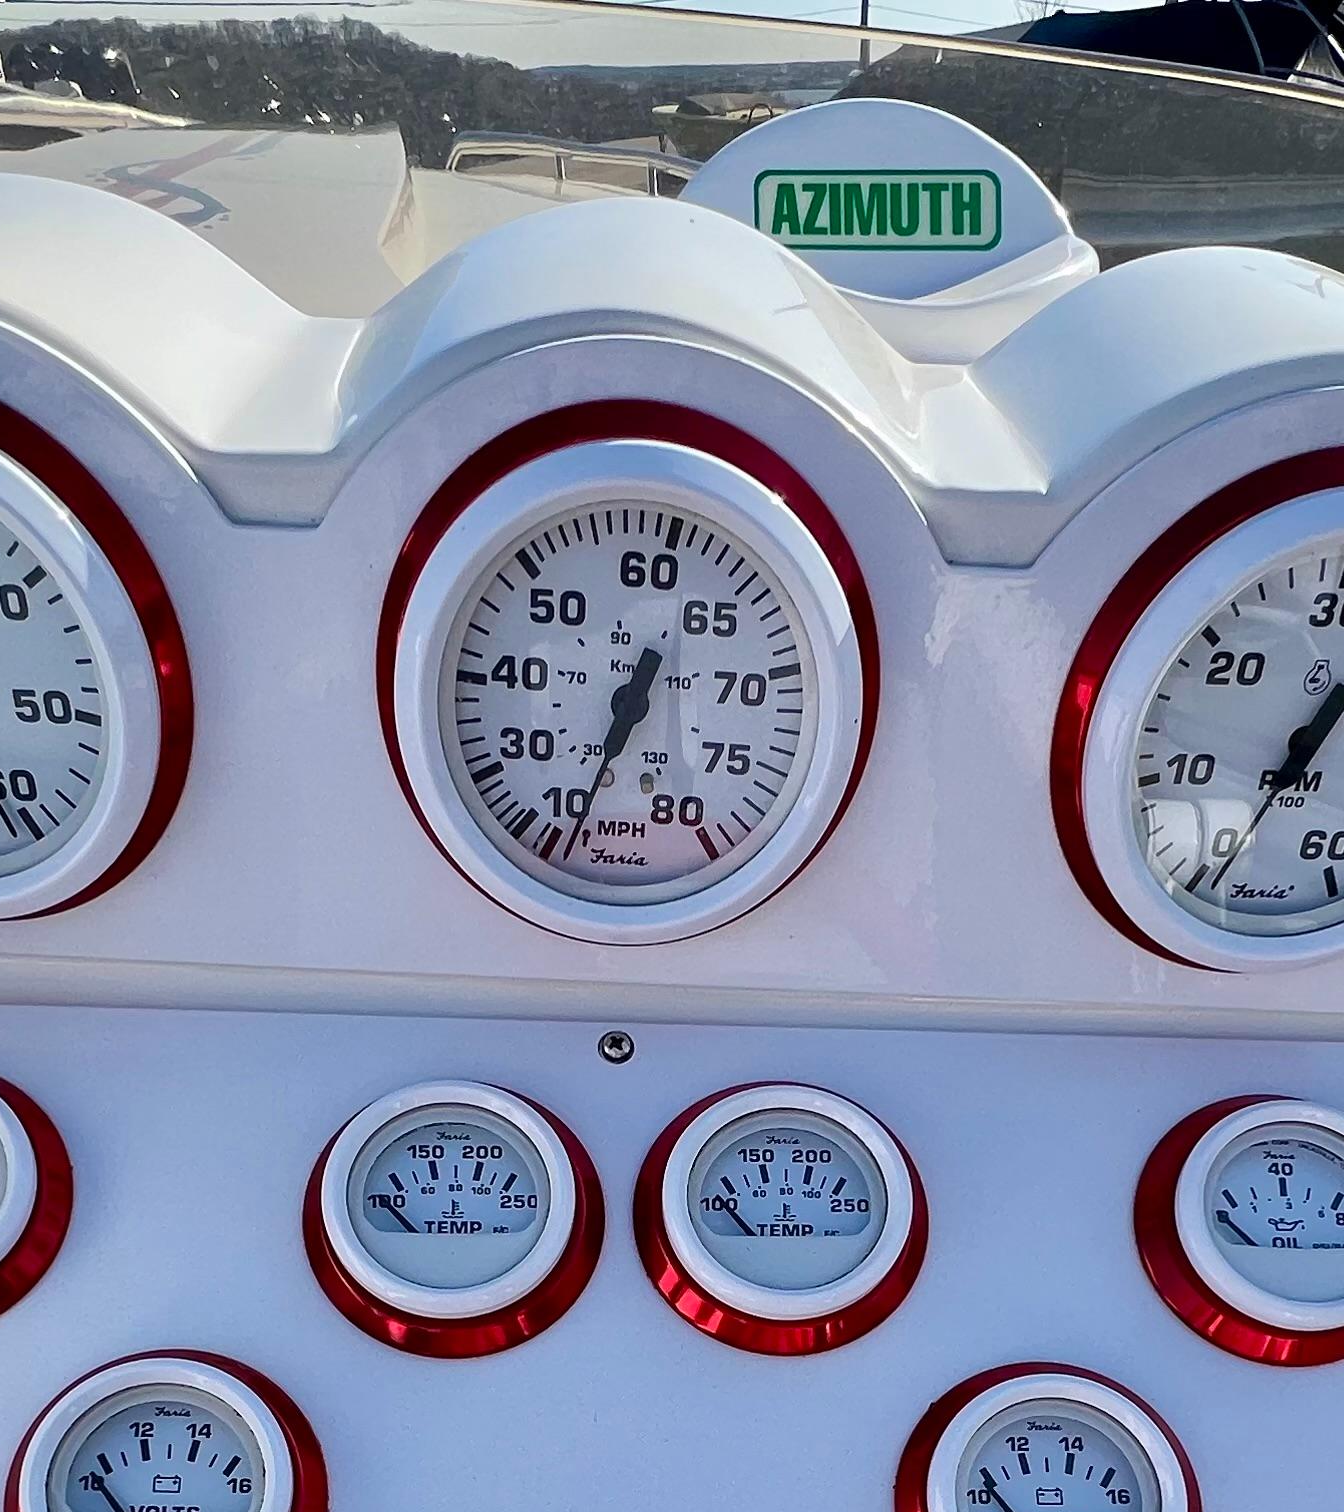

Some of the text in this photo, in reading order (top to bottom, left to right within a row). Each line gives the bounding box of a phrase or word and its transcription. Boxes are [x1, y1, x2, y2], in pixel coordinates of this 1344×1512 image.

[772, 182, 982, 237] AZIMUTH
[620, 552, 678, 590] 60
[530, 589, 586, 625] 50
[683, 601, 737, 637] 65
[610, 631, 631, 645] 90
[491, 656, 548, 690] 40
[1205, 652, 1265, 686] 20
[566, 671, 587, 685] 70
[664, 676, 692, 690] 110
[714, 672, 766, 706] 70
[13, 690, 72, 724] 50
[500, 728, 554, 761] 30
[583, 744, 603, 756] 30
[641, 751, 668, 764] 130
[702, 742, 750, 775] 75
[1167, 753, 1215, 785] 10
[1258, 769, 1323, 792] RM
[542, 788, 589, 818] 10
[651, 794, 703, 826] 80
[597, 820, 645, 837] MPH
[1212, 828, 1238, 857] 0
[407, 1145, 445, 1159] 150
[461, 1145, 503, 1159] 200
[737, 1149, 775, 1163] 150
[792, 1150, 831, 1163] 200
[1268, 1162, 1293, 1176] 40
[420, 1186, 435, 1195] 60
[448, 1184, 463, 1192] 80
[471, 1187, 491, 1196] 100
[752, 1189, 767, 1198] 60
[779, 1187, 793, 1196] 80
[802, 1190, 821, 1199] 100
[368, 1194, 406, 1209] 100
[500, 1195, 538, 1209] 250
[700, 1197, 738, 1212] 100
[830, 1199, 869, 1213] 250
[1285, 1202, 1293, 1210] 3
[424, 1221, 483, 1234] TEMP
[757, 1223, 814, 1236] TEMP
[1272, 1237, 1303, 1249] OIL
[130, 1422, 154, 1437] 12
[186, 1424, 212, 1438] 14
[1006, 1436, 1029, 1451] 12
[1059, 1437, 1083, 1451] 14
[78, 1475, 104, 1491] 10
[227, 1478, 252, 1493] 16
[967, 1489, 991, 1504] 10
[1106, 1489, 1130, 1504] 16
